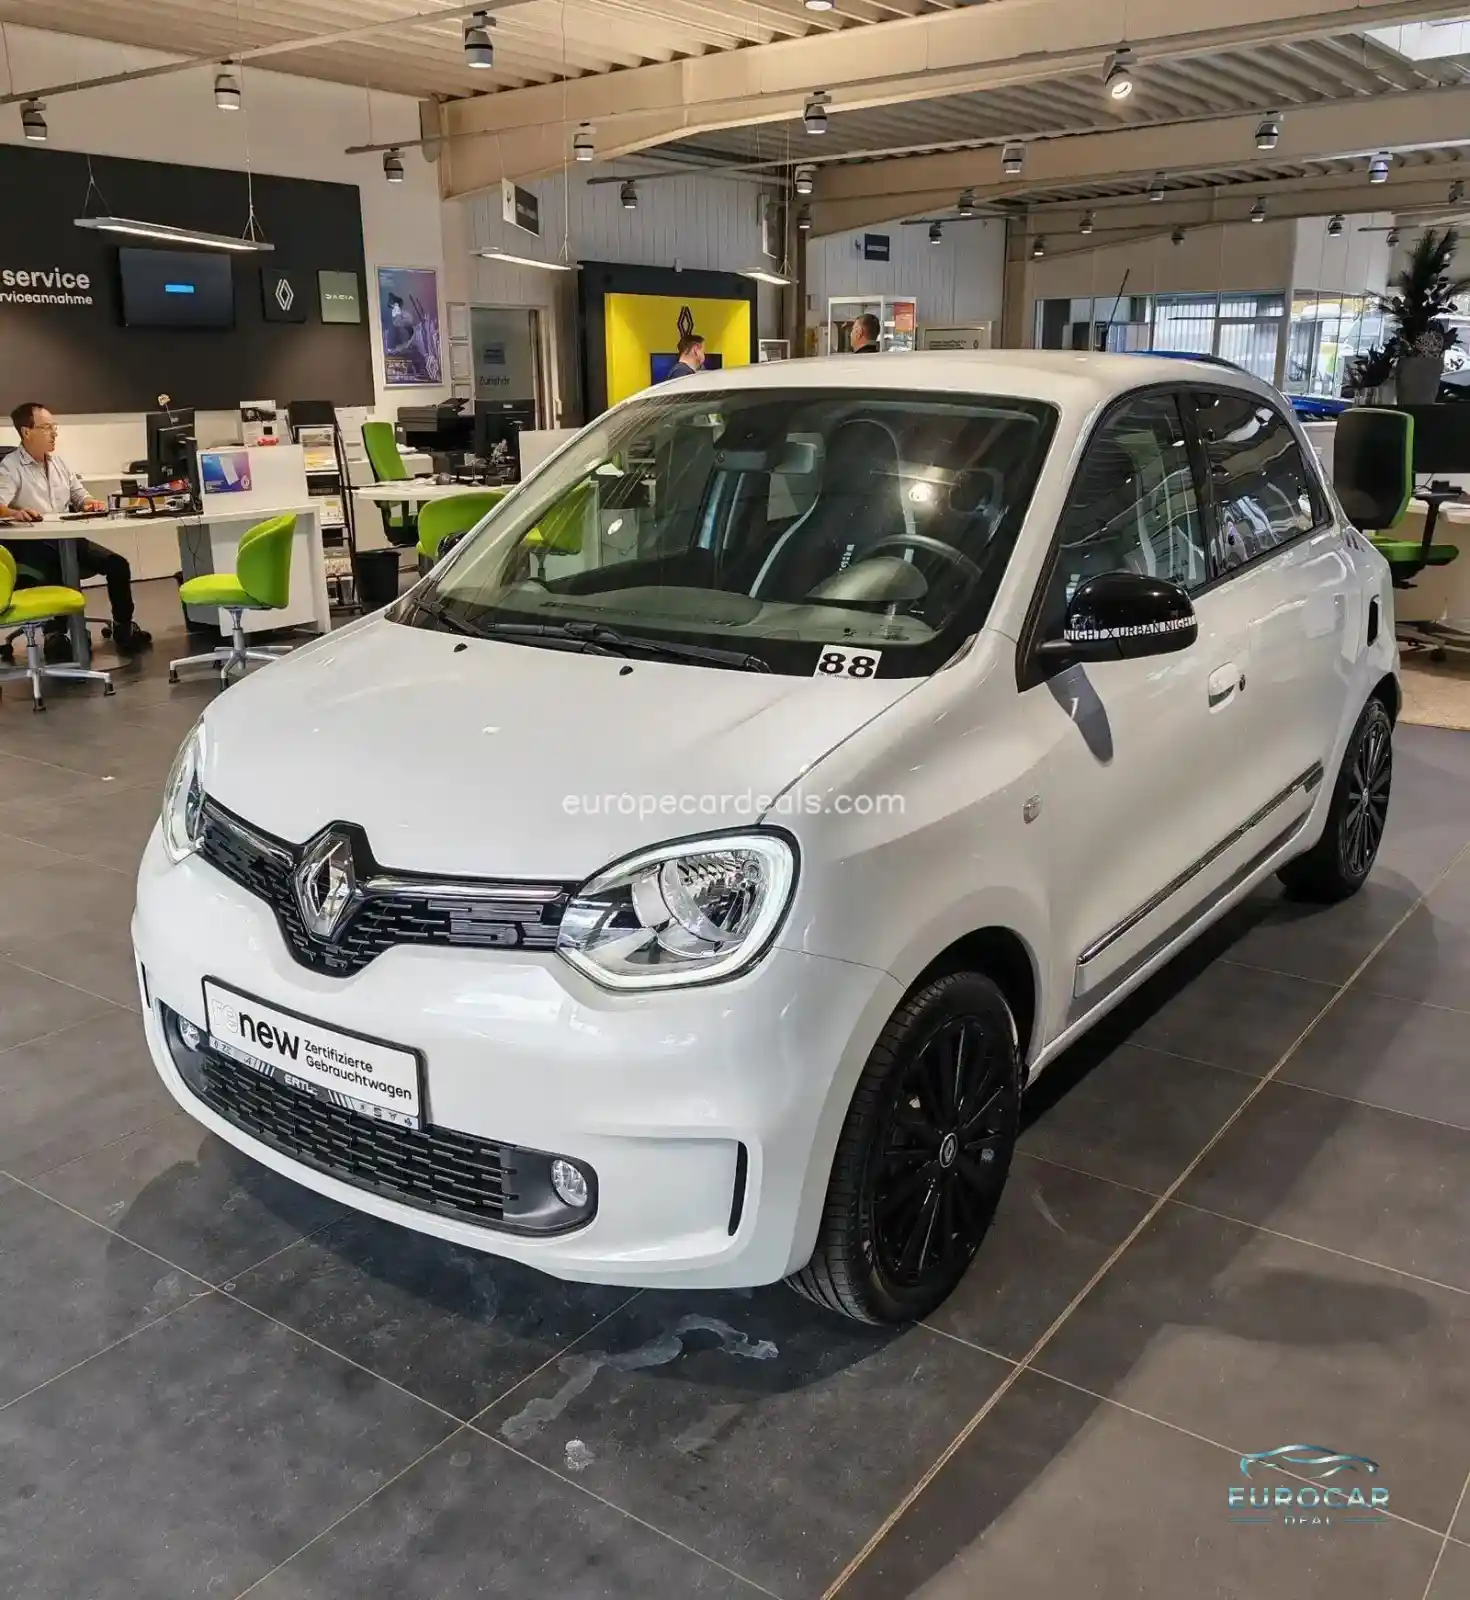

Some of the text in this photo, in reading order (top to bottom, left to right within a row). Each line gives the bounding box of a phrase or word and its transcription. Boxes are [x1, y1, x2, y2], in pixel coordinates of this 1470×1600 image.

[2, 267, 91, 289] service
[1118, 623, 1161, 637] URBAN
[818, 652, 876, 678] 88
[304, 1039, 373, 1073] Zertifizierte
[306, 1055, 412, 1101] Gebrauchtwagen
